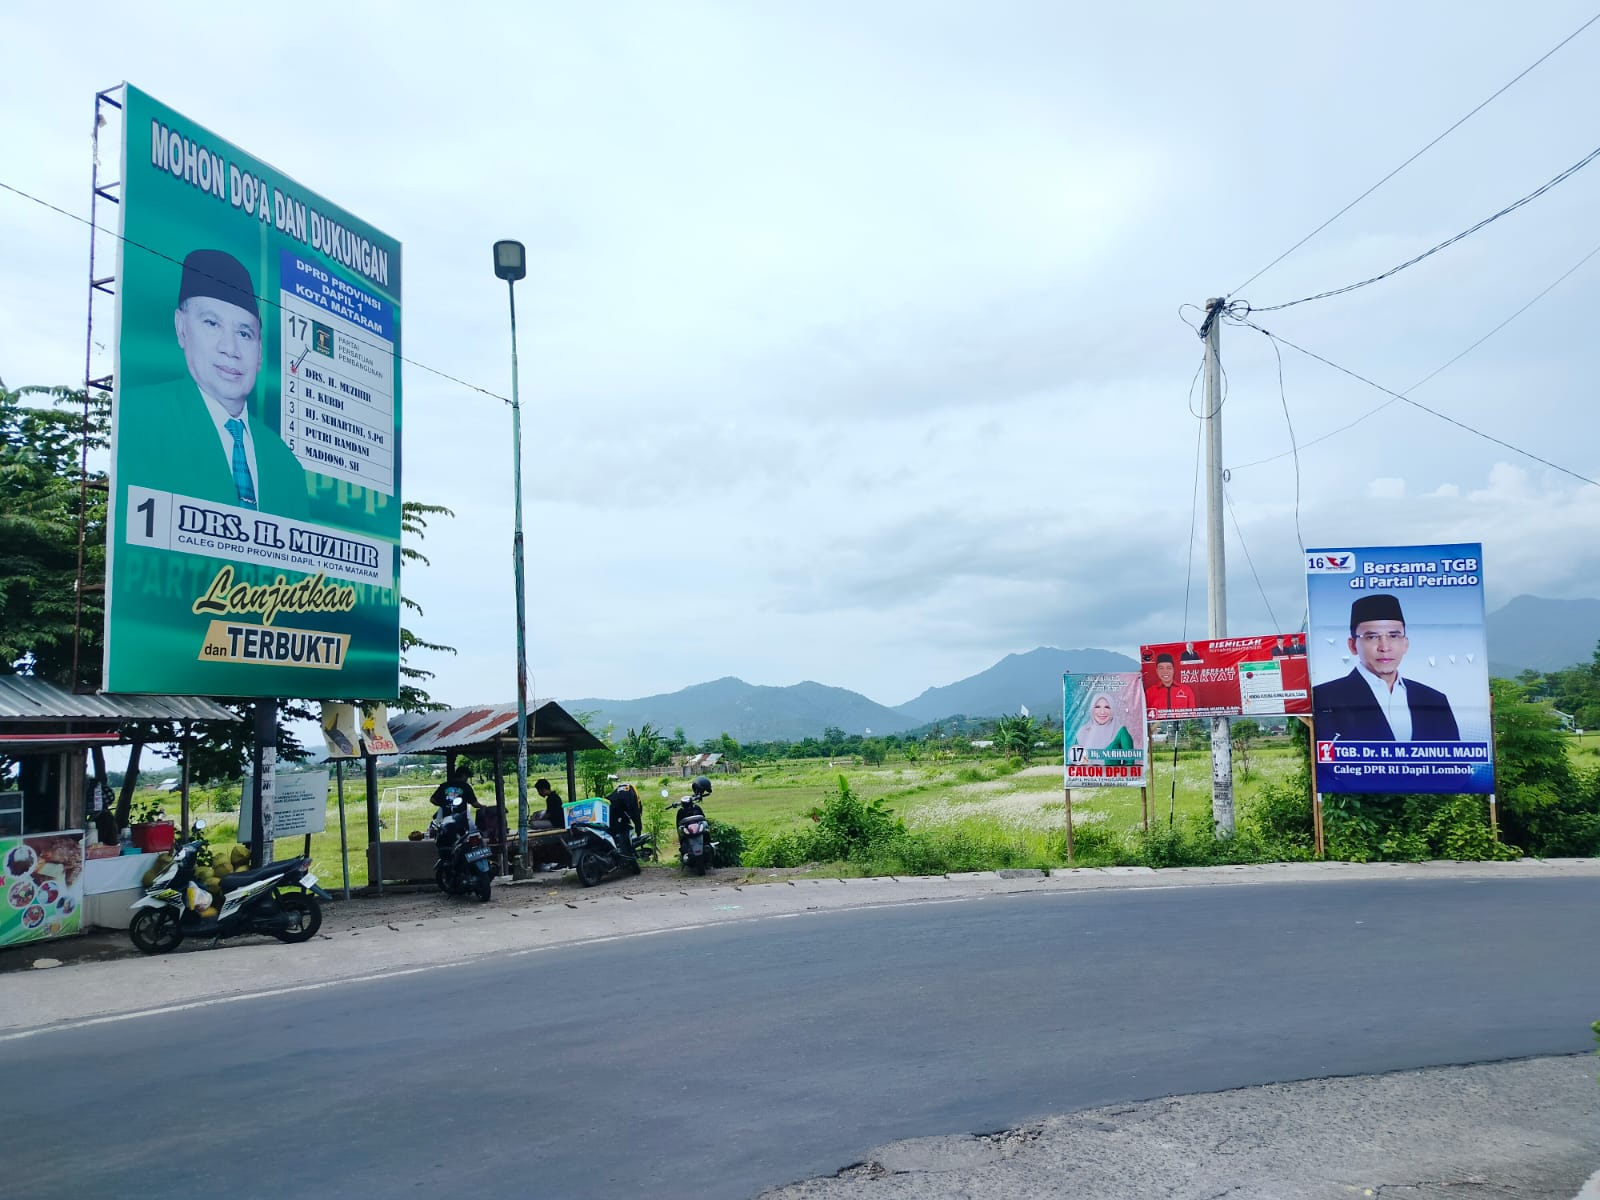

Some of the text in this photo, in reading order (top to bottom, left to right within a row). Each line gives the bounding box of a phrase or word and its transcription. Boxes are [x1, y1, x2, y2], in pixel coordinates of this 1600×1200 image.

[151, 119, 388, 287] MOHON DO'A DAN DUKUNGAN
[296, 259, 382, 311] DPRD PROVINSI
[296, 283, 383, 335] KOTA MATARAM
[322, 285, 363, 312] DAPIL 1
[289, 315, 308, 341] 17
[338, 336, 360, 351] PARTAI
[289, 381, 344, 411] 2 H. KURDI
[305, 367, 326, 385] DRS.
[328, 376, 337, 389] H.
[340, 381, 372, 403] MUZIHIR
[289, 401, 295, 414] 3
[305, 407, 319, 421] HJ.
[289, 420, 370, 458] 4 PUTRI RAMDANI
[289, 439, 295, 451] 5
[349, 460, 360, 472] SH
[136, 497, 379, 569] 1 DRS. H. MUZIHIR
[178, 535, 215, 548] CALEG
[217, 541, 245, 554] DPRD
[247, 547, 289, 562] PROVINSI
[291, 555, 315, 567] DAPIL
[323, 561, 343, 572] KOTA
[345, 565, 379, 578] MATARAM
[1308, 557, 1324, 569] 16
[1363, 558, 1478, 575] Bersama TGB
[1350, 574, 1478, 588] di Partai Perindo
[194, 566, 355, 624] Lanjutkan
[204, 625, 341, 665] dan TERBUKTI
[1180, 672, 1236, 684] RAKYAT
[1147, 709, 1156, 718] 4
[1072, 747, 1084, 762] 17
[1321, 743, 1487, 761] 1 TGB. Dr. H. M. ZAINUL MAJDI
[1068, 766, 1142, 777] CALON DPD RI
[1333, 764, 1475, 776] Caleg DPR RI Dapil Lombok
